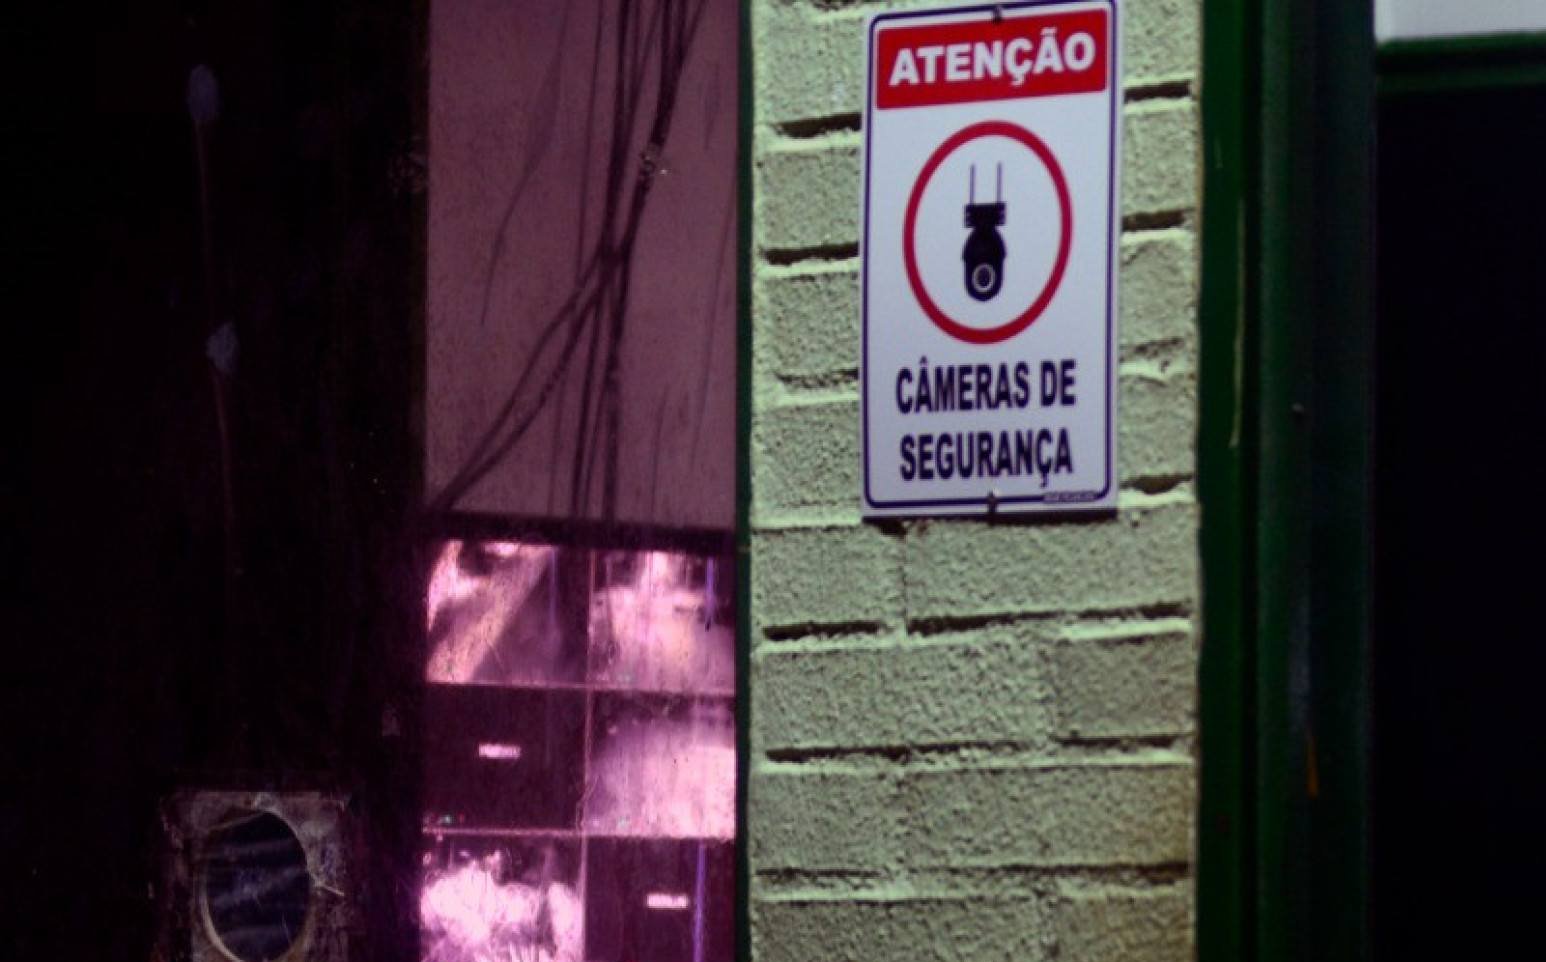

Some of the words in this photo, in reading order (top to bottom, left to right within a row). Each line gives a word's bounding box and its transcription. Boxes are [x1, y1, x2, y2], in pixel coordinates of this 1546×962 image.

[888, 27, 1096, 87] ATENÇÃO
[896, 356, 1031, 414] CÂMERAS
[1040, 359, 1076, 407] DE
[900, 427, 1073, 488] SEGURANÇA
